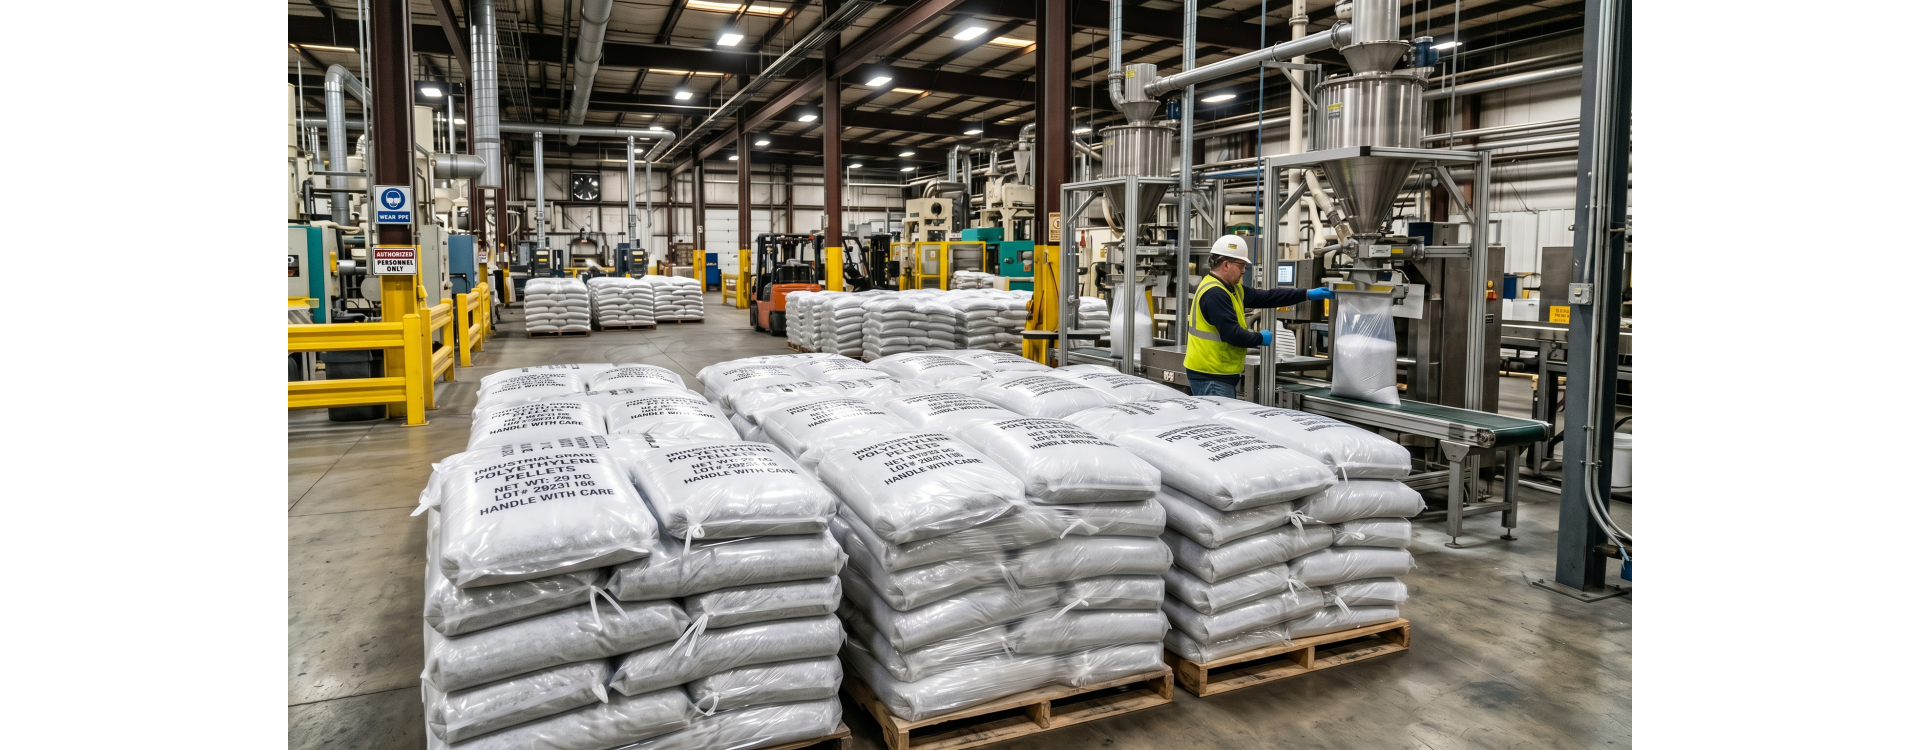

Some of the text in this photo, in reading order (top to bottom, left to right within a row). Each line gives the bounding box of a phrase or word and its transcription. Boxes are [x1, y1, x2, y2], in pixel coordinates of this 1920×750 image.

[630, 411, 664, 420] HANDLE
[490, 424, 528, 434] HANDLE
[886, 443, 940, 458] PELLETS
[474, 456, 553, 475] INDUSTRIAL
[884, 458, 906, 467] NET
[474, 458, 599, 483] POLYETHYLENE
[505, 466, 576, 482] PELLETS
[684, 471, 732, 484] HANDLE
[884, 467, 927, 485] HANDLE
[926, 460, 954, 470] WITH
[494, 483, 519, 493] NET
[525, 478, 549, 486] WT:
[495, 489, 528, 501] LOT#
[480, 497, 536, 515] HANDLE
[540, 491, 576, 502] WITH
